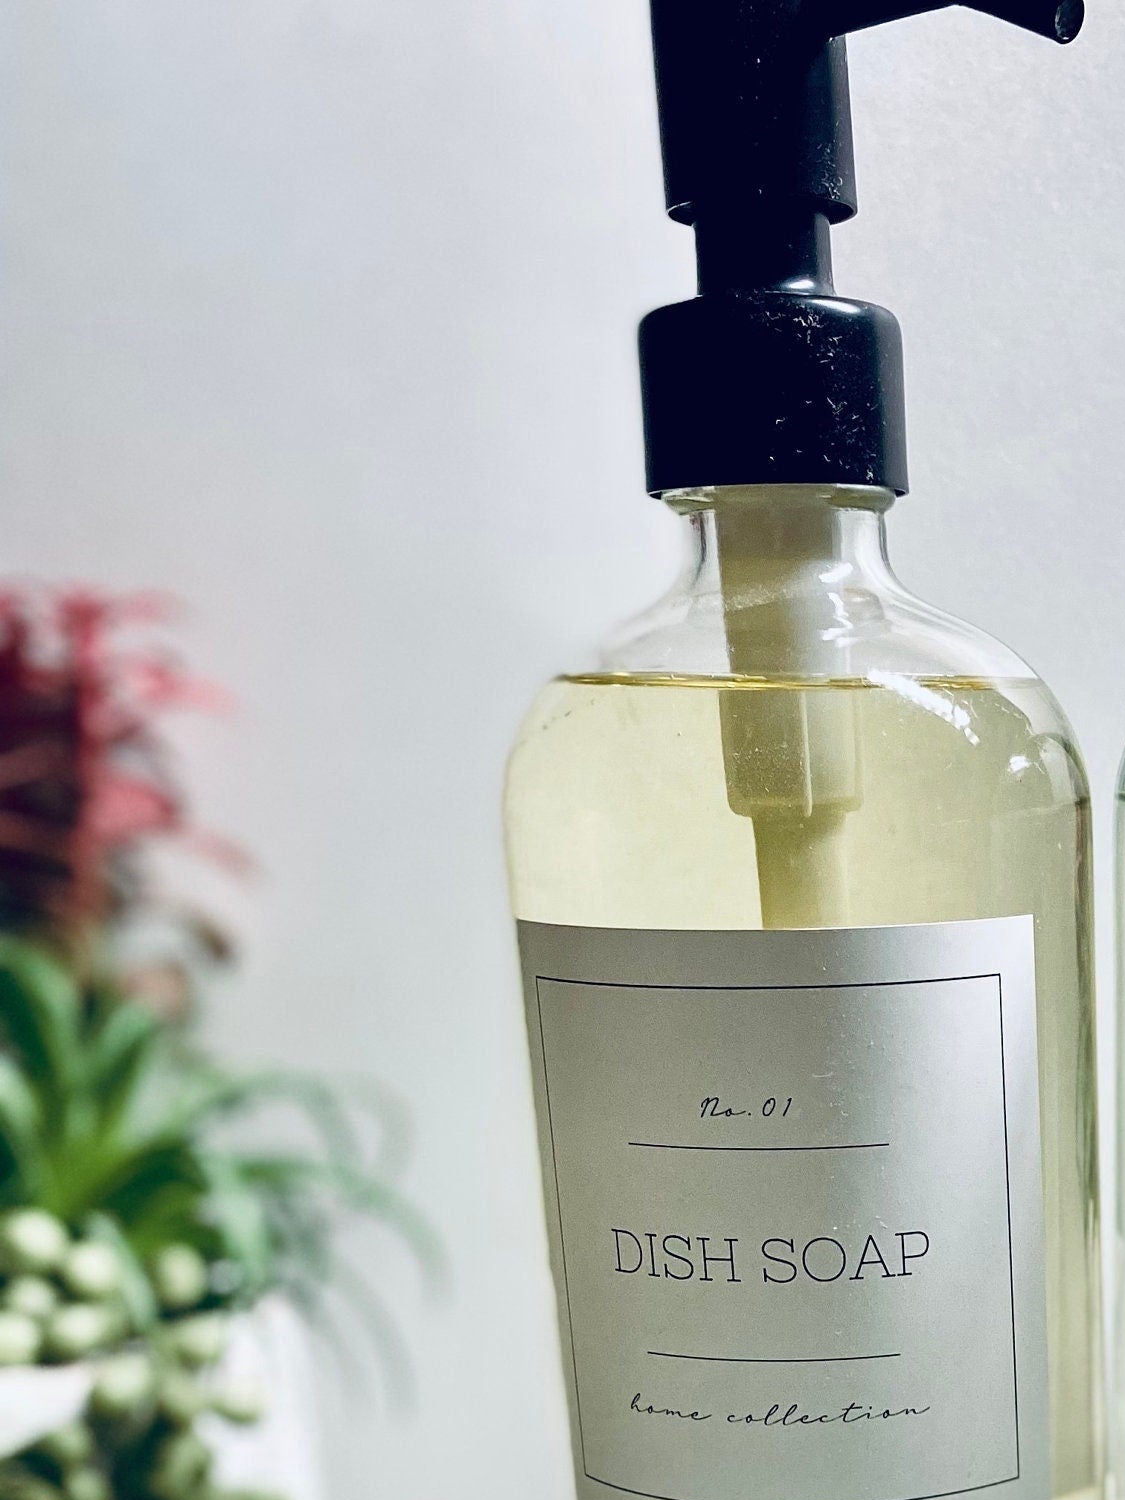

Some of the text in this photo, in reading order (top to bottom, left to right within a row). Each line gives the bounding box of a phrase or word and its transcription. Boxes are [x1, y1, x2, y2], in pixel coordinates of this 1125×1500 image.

[700, 1096, 793, 1119] No. 01
[610, 1228, 930, 1284] DISH SOAP
[630, 1392, 931, 1427] home collection
